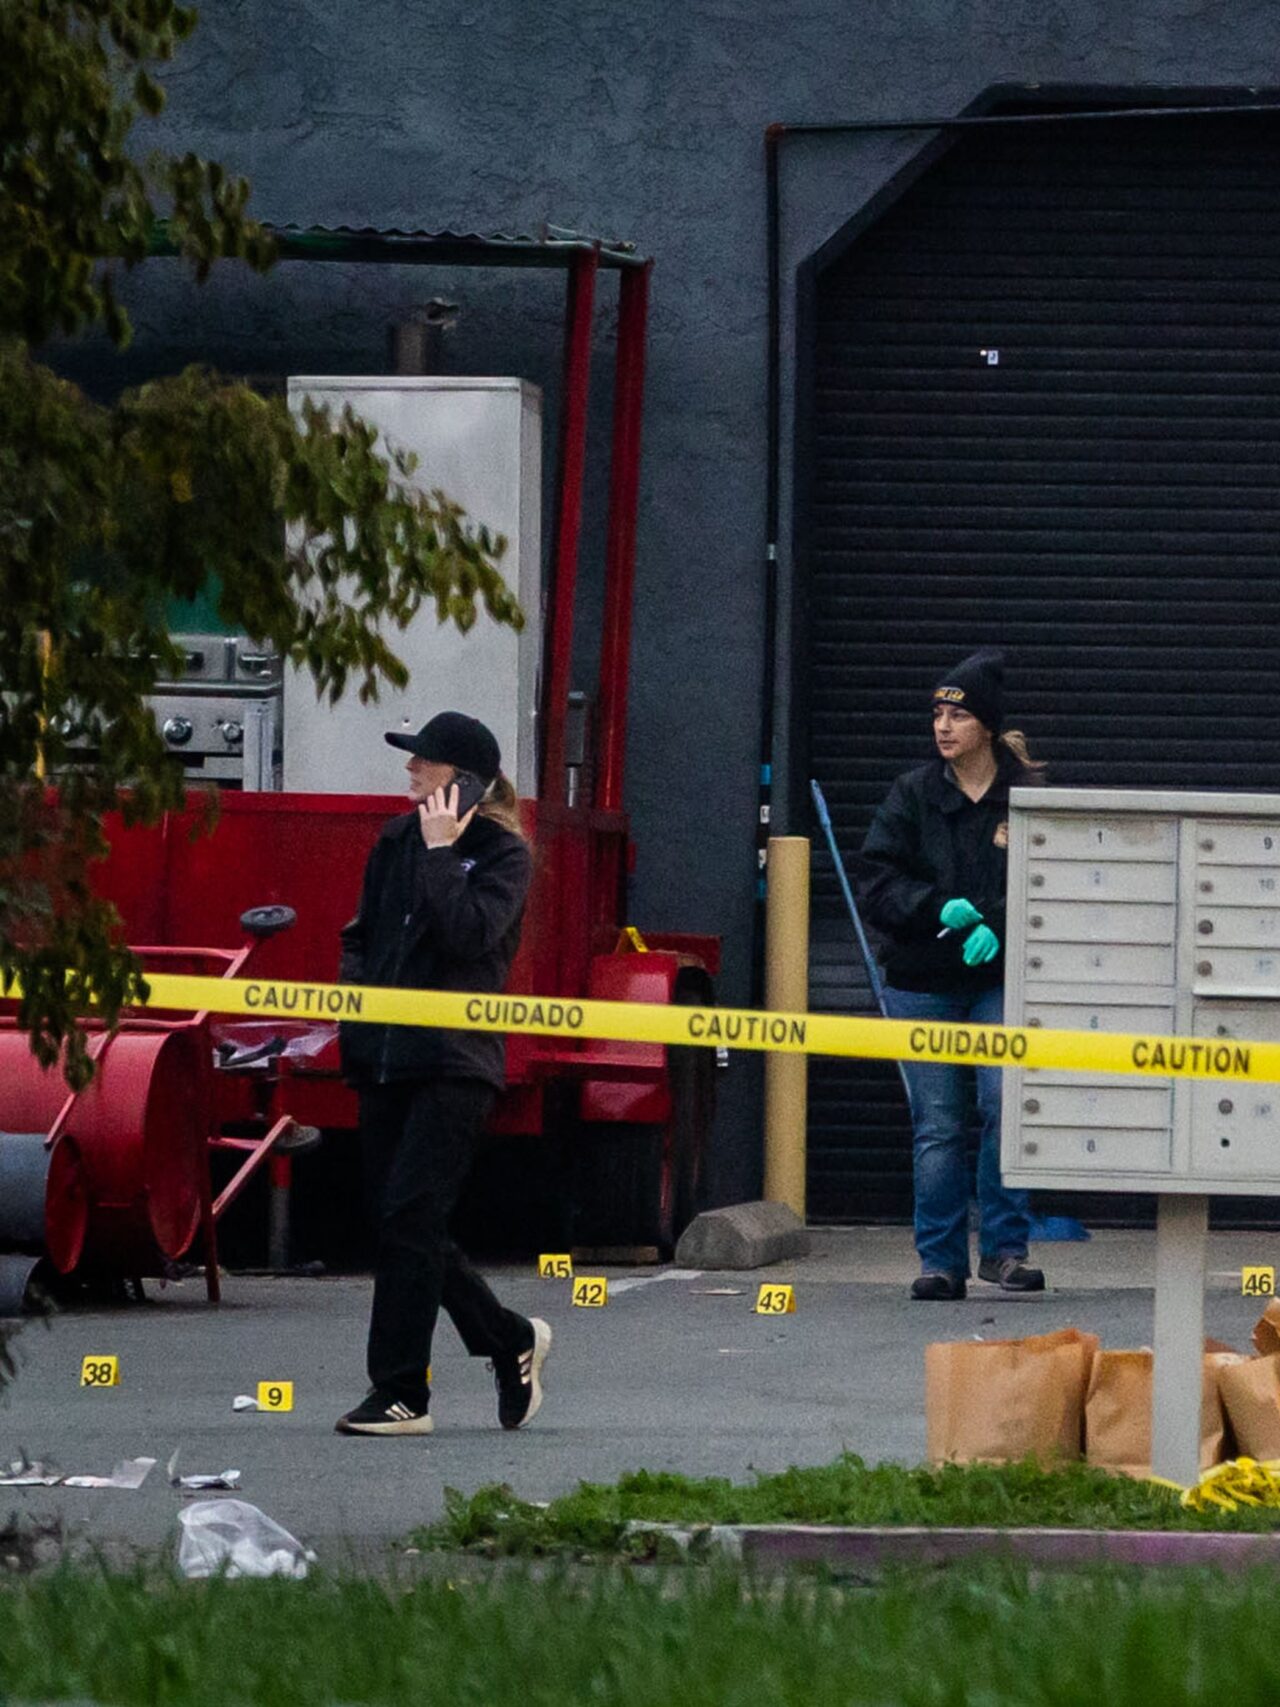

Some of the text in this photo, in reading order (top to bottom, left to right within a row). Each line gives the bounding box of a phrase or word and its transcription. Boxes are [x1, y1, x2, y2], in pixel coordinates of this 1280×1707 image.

[1263, 836, 1274, 850] 9
[244, 985, 363, 1013] CAUTION
[466, 999, 584, 1029] CUIDADO
[689, 1014, 806, 1044] CAUTION
[910, 1028, 1027, 1060] CUIDADO
[1132, 1042, 1250, 1073] CAUTION
[543, 1260, 570, 1278] 45
[1245, 1273, 1272, 1293] 46
[575, 1284, 602, 1304] 42
[760, 1291, 787, 1311] 43
[83, 1362, 113, 1385] 38
[267, 1387, 283, 1407] 9
